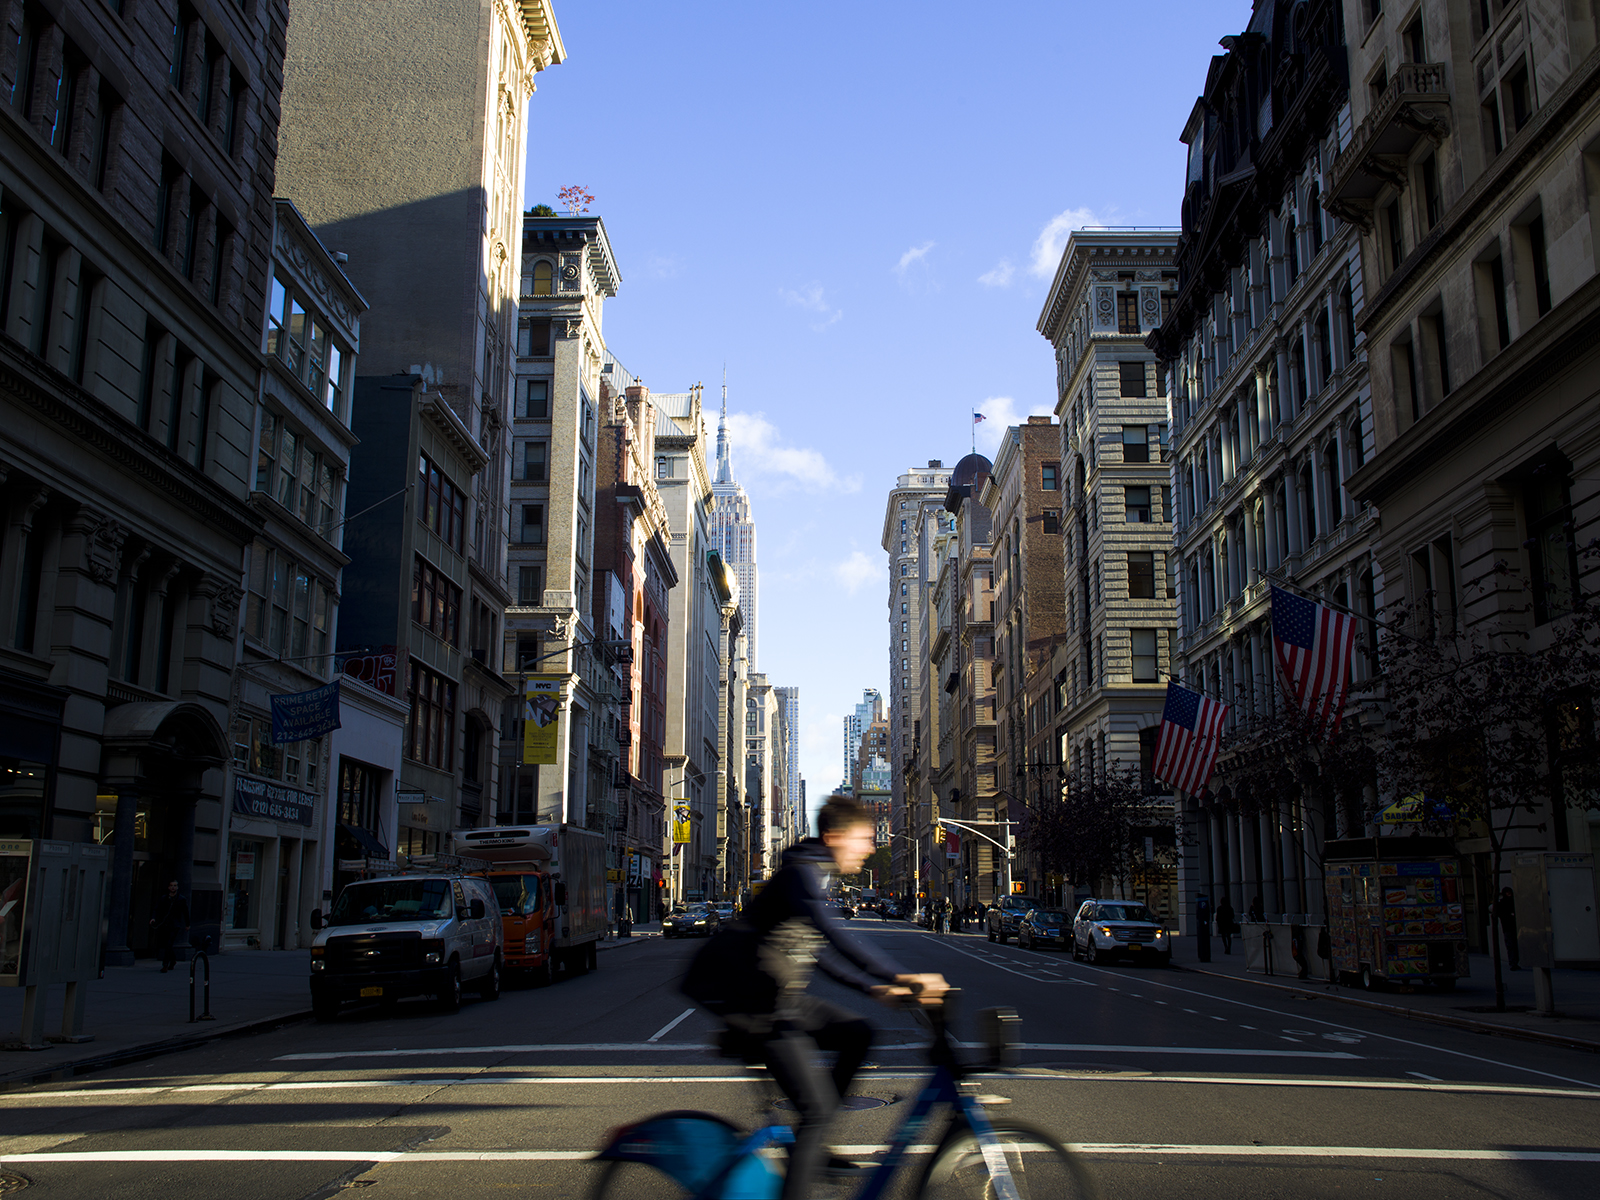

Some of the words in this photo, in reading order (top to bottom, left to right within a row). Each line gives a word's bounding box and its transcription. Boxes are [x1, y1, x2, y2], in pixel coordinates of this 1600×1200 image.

[273, 695, 303, 706] PRIME
[305, 685, 337, 702] RETAIL
[283, 708, 331, 727] AVAILABLE
[290, 702, 321, 716] SPACE
[276, 718, 337, 740] 212-645-3434
[236, 776, 267, 796] FLAGSHIP
[286, 790, 298, 804] FOR
[298, 792, 314, 808] LEASE
[252, 799, 269, 815] (212)
[269, 803, 299, 820] 645-3434
